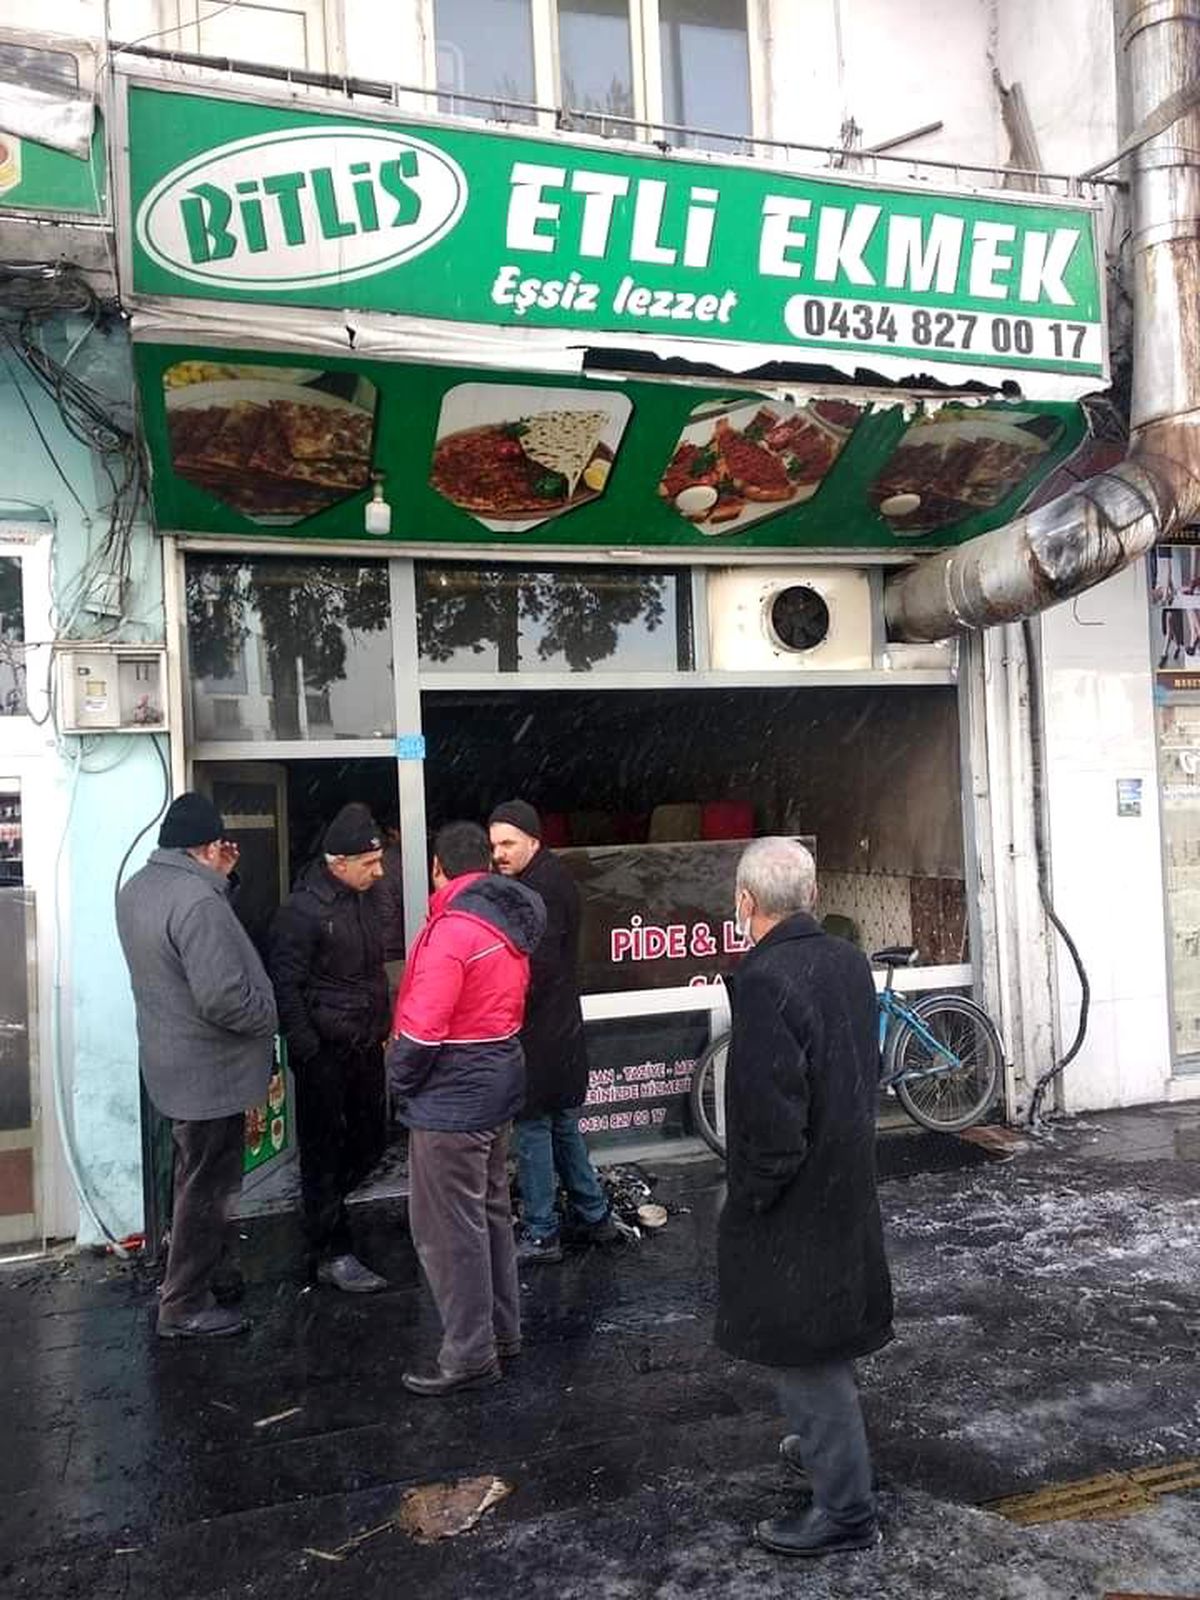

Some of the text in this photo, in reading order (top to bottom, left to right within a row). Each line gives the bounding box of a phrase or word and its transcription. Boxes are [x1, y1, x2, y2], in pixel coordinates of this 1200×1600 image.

[758, 195, 1081, 306] EKMEK
[491, 266, 738, 323] Eşsiz lezzet
[804, 300, 1087, 359] 0434 827 00 17
[611, 915, 687, 962] PİDE
[691, 923, 716, 957] &
